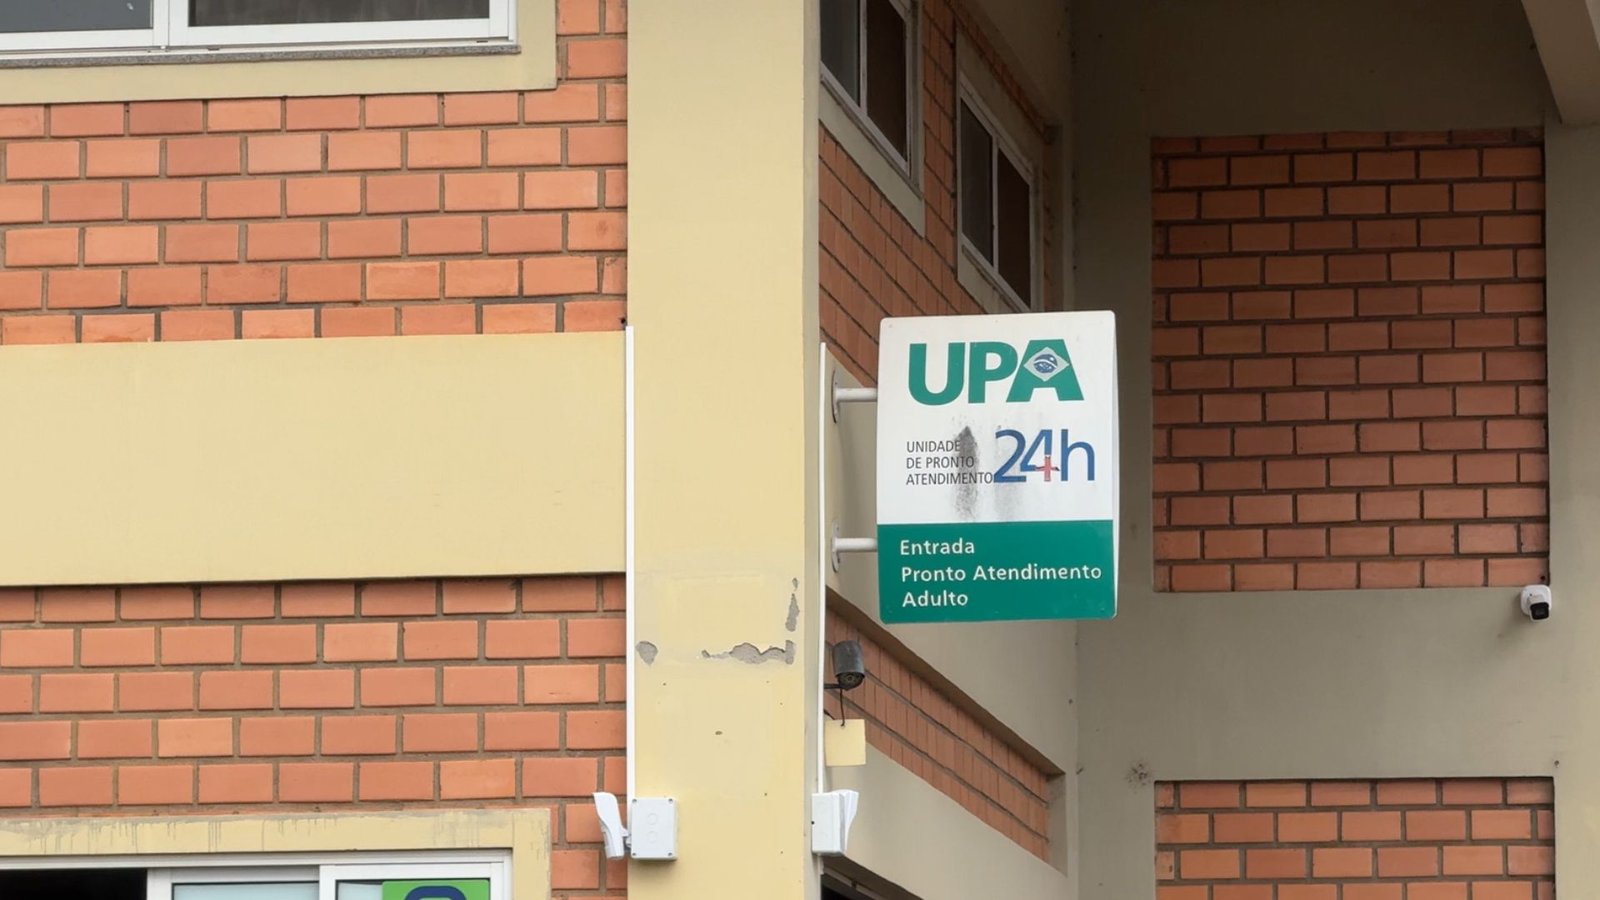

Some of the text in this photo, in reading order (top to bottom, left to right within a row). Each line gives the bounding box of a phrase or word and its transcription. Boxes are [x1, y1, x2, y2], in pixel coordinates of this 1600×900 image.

[908, 339, 1084, 406] UPA
[906, 440, 961, 453] UNIDADE
[906, 455, 975, 469] DE PRONTO
[993, 428, 1096, 484] 24h
[906, 473, 993, 486] ATENDIMENTO
[900, 537, 975, 556] Entrada
[902, 563, 1102, 582] Pronto Atendimento
[902, 590, 969, 607] Adulto
